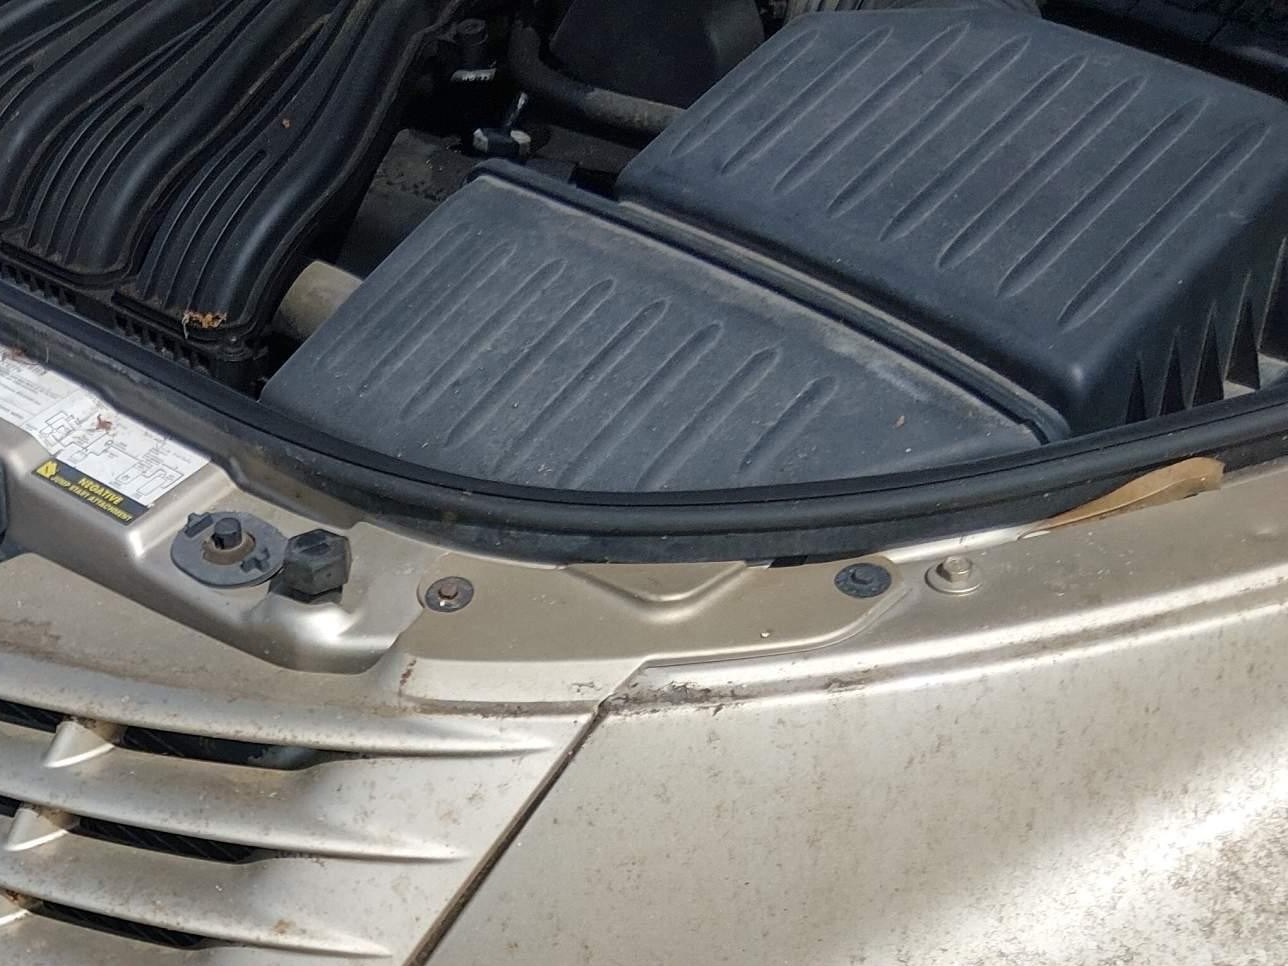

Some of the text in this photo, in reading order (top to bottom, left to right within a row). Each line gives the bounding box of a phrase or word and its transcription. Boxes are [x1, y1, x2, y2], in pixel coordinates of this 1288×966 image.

[68, 484, 90, 499] START
[88, 496, 132, 521] ATTACHMENT
[78, 478, 123, 505] NEGATIVE
